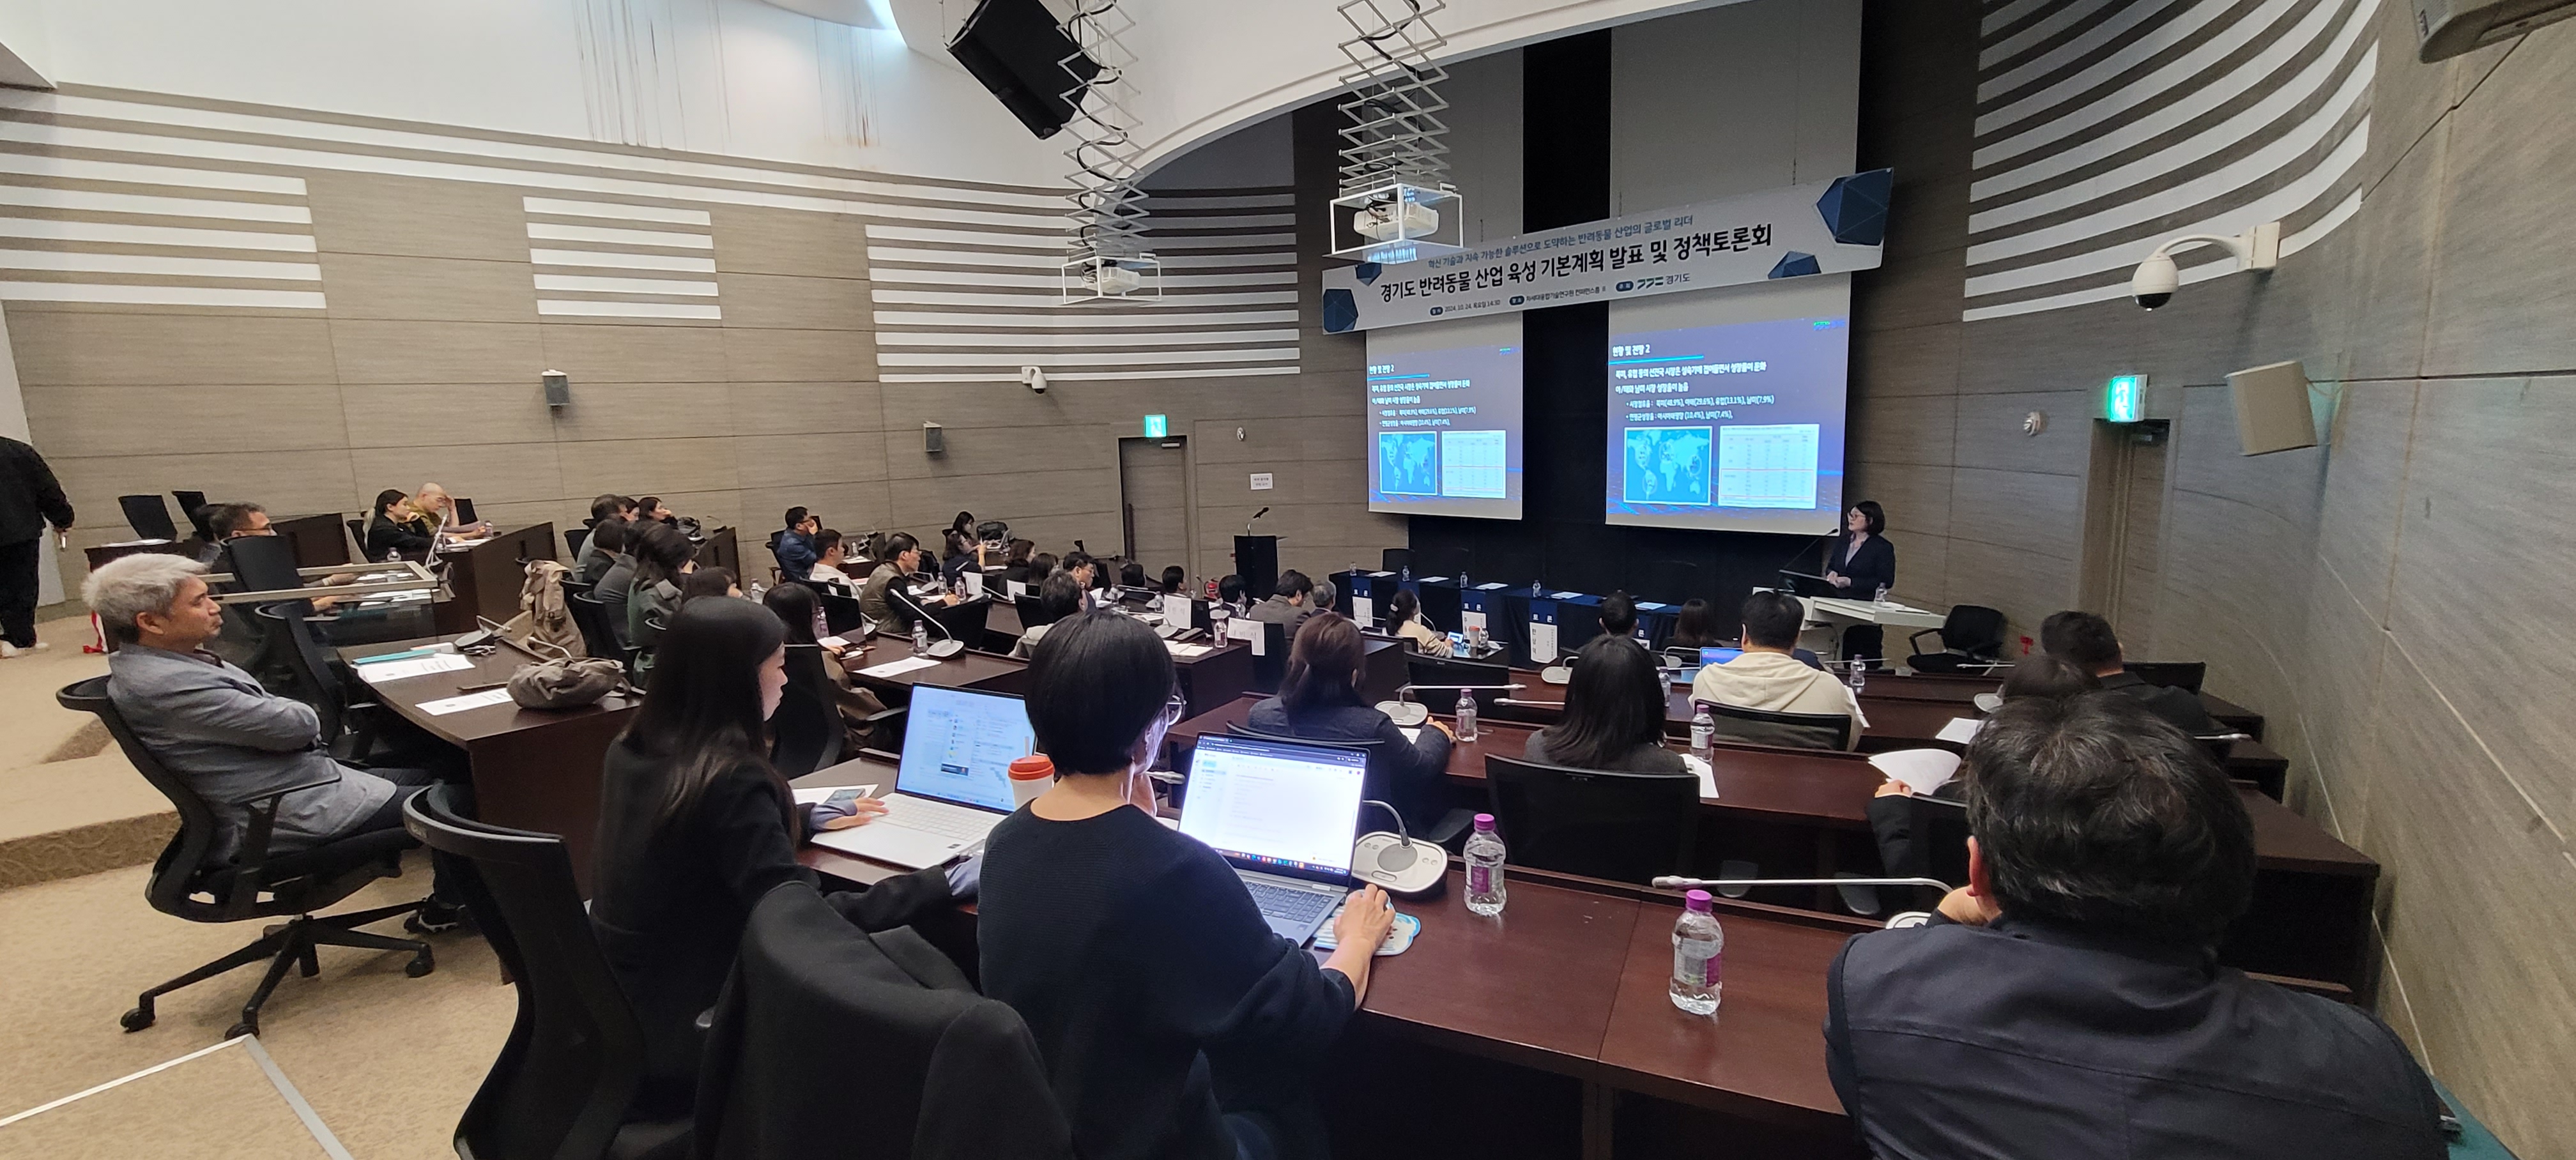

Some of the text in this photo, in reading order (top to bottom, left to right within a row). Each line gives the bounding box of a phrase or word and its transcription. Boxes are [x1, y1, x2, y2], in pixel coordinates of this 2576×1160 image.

[1428, 215, 1693, 269] 혁신 기술과 지속 가능한 솔루션으로 도약하는 반려동물 산업의 글로벌 리더
[1381, 224, 1772, 303] 경기도 반려동물 산업 육성 기본계획 발표 및 정책토론회
[1666, 273, 1690, 285] 경기도
[1645, 344, 1650, 353] 2
